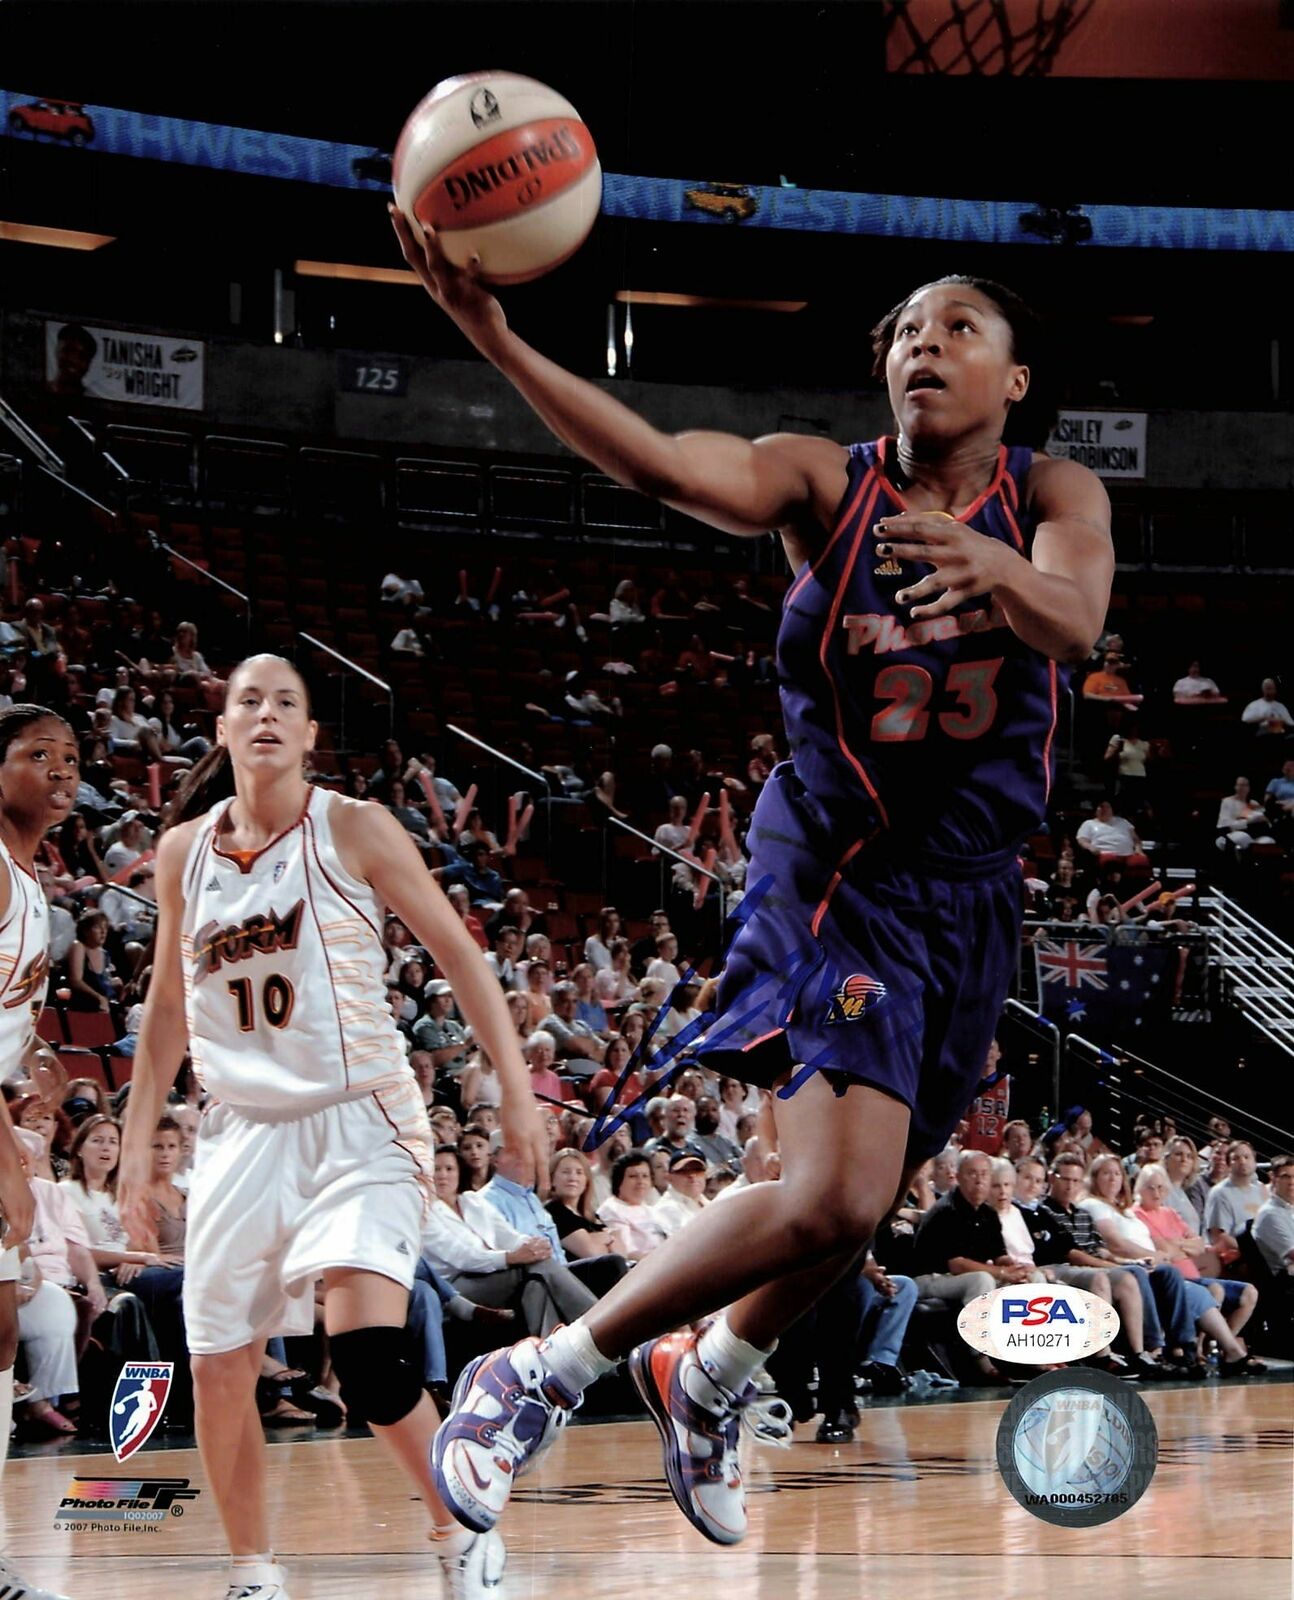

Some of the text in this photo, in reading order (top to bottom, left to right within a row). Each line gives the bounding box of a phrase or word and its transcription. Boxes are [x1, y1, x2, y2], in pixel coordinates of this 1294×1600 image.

[444, 126, 580, 210] SPALDING
[1093, 204, 1293, 252] ORTHW
[102, 337, 162, 369] TANISHA
[124, 368, 180, 399] WRIGHT
[356, 367, 399, 390] 125
[1054, 418, 1102, 443] SHLEY
[870, 657, 1004, 742] 23
[228, 974, 295, 1032] 10
[977, 1116, 999, 1137] 12
